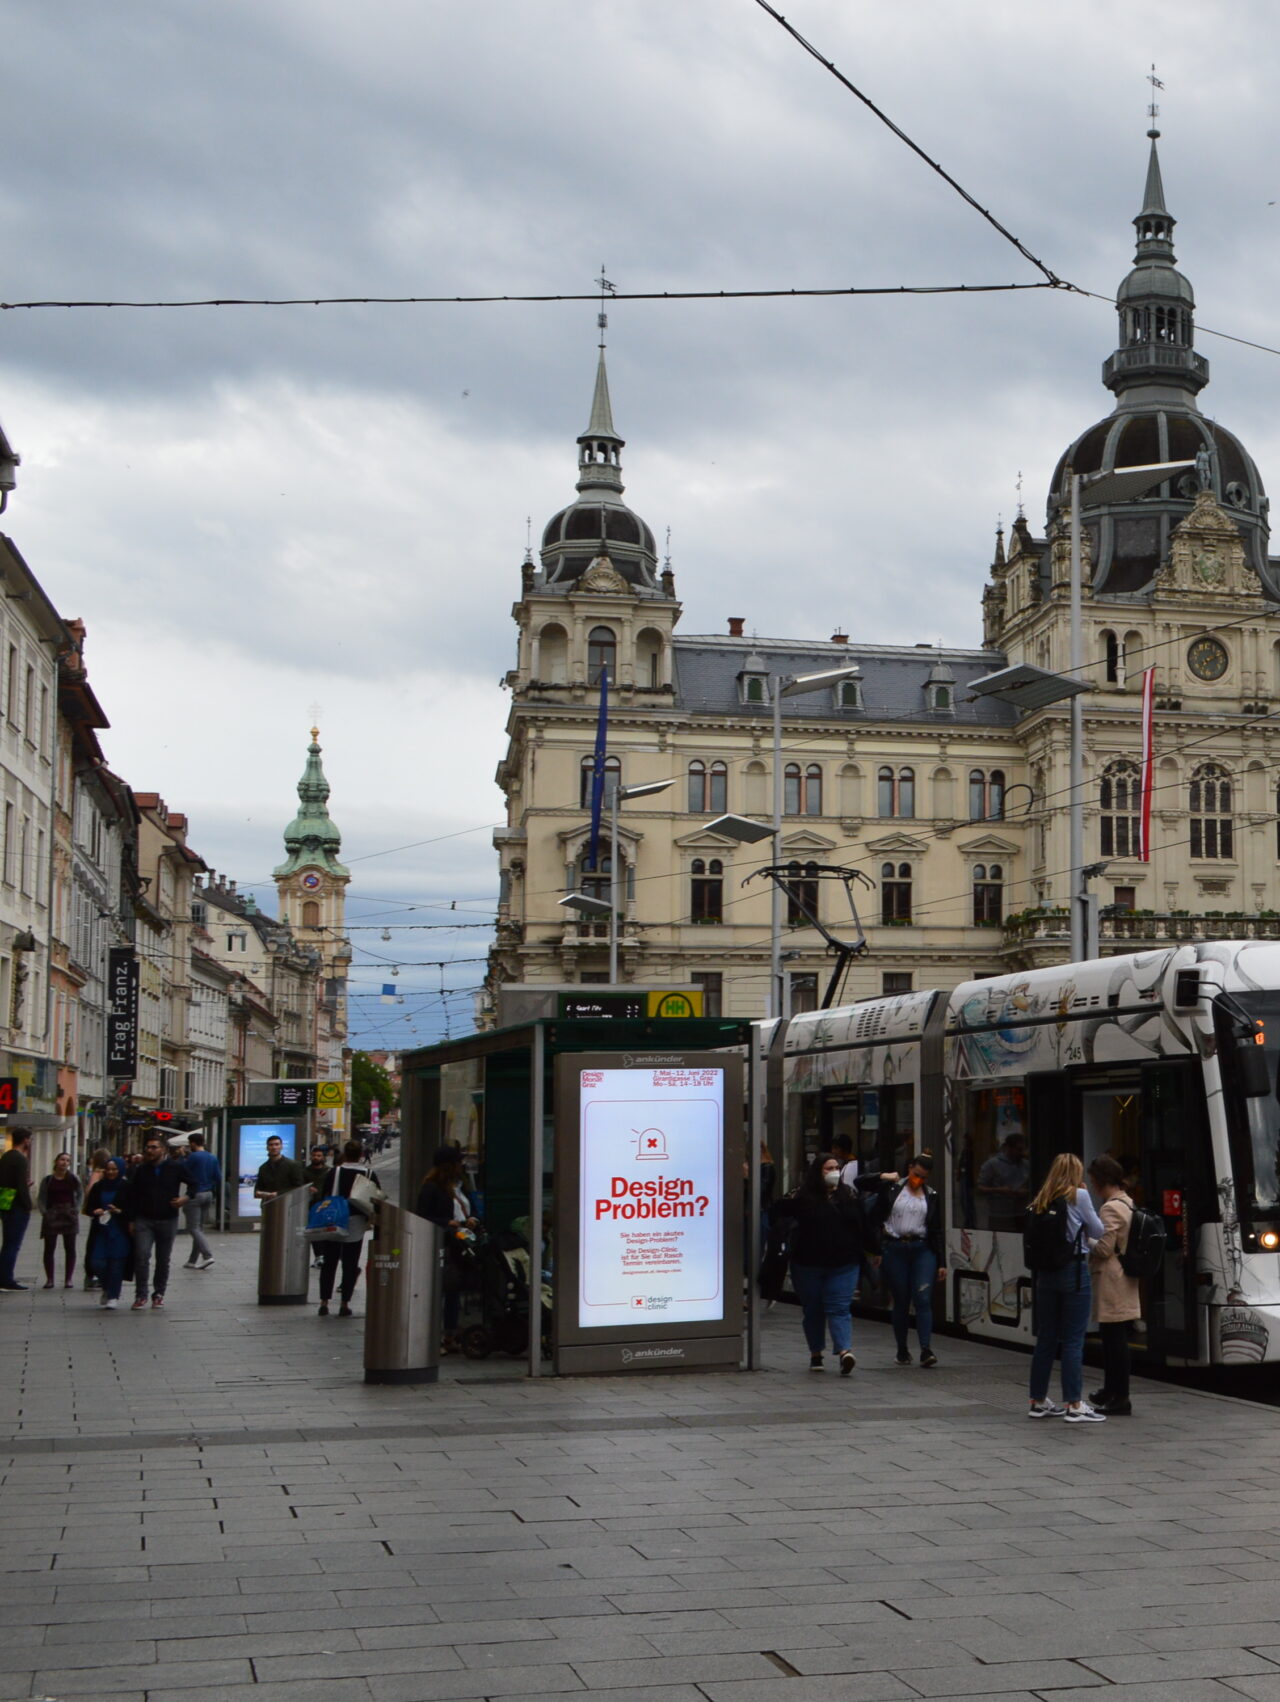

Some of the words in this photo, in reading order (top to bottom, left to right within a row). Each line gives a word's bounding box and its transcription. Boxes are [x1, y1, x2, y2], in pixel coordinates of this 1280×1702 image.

[112, 961, 129, 1016] Franz.
[111, 1021, 131, 1061] Frag
[611, 1175, 694, 1201] Design
[595, 1196, 709, 1220] Problem?
[634, 1346, 683, 1357] ankünder
